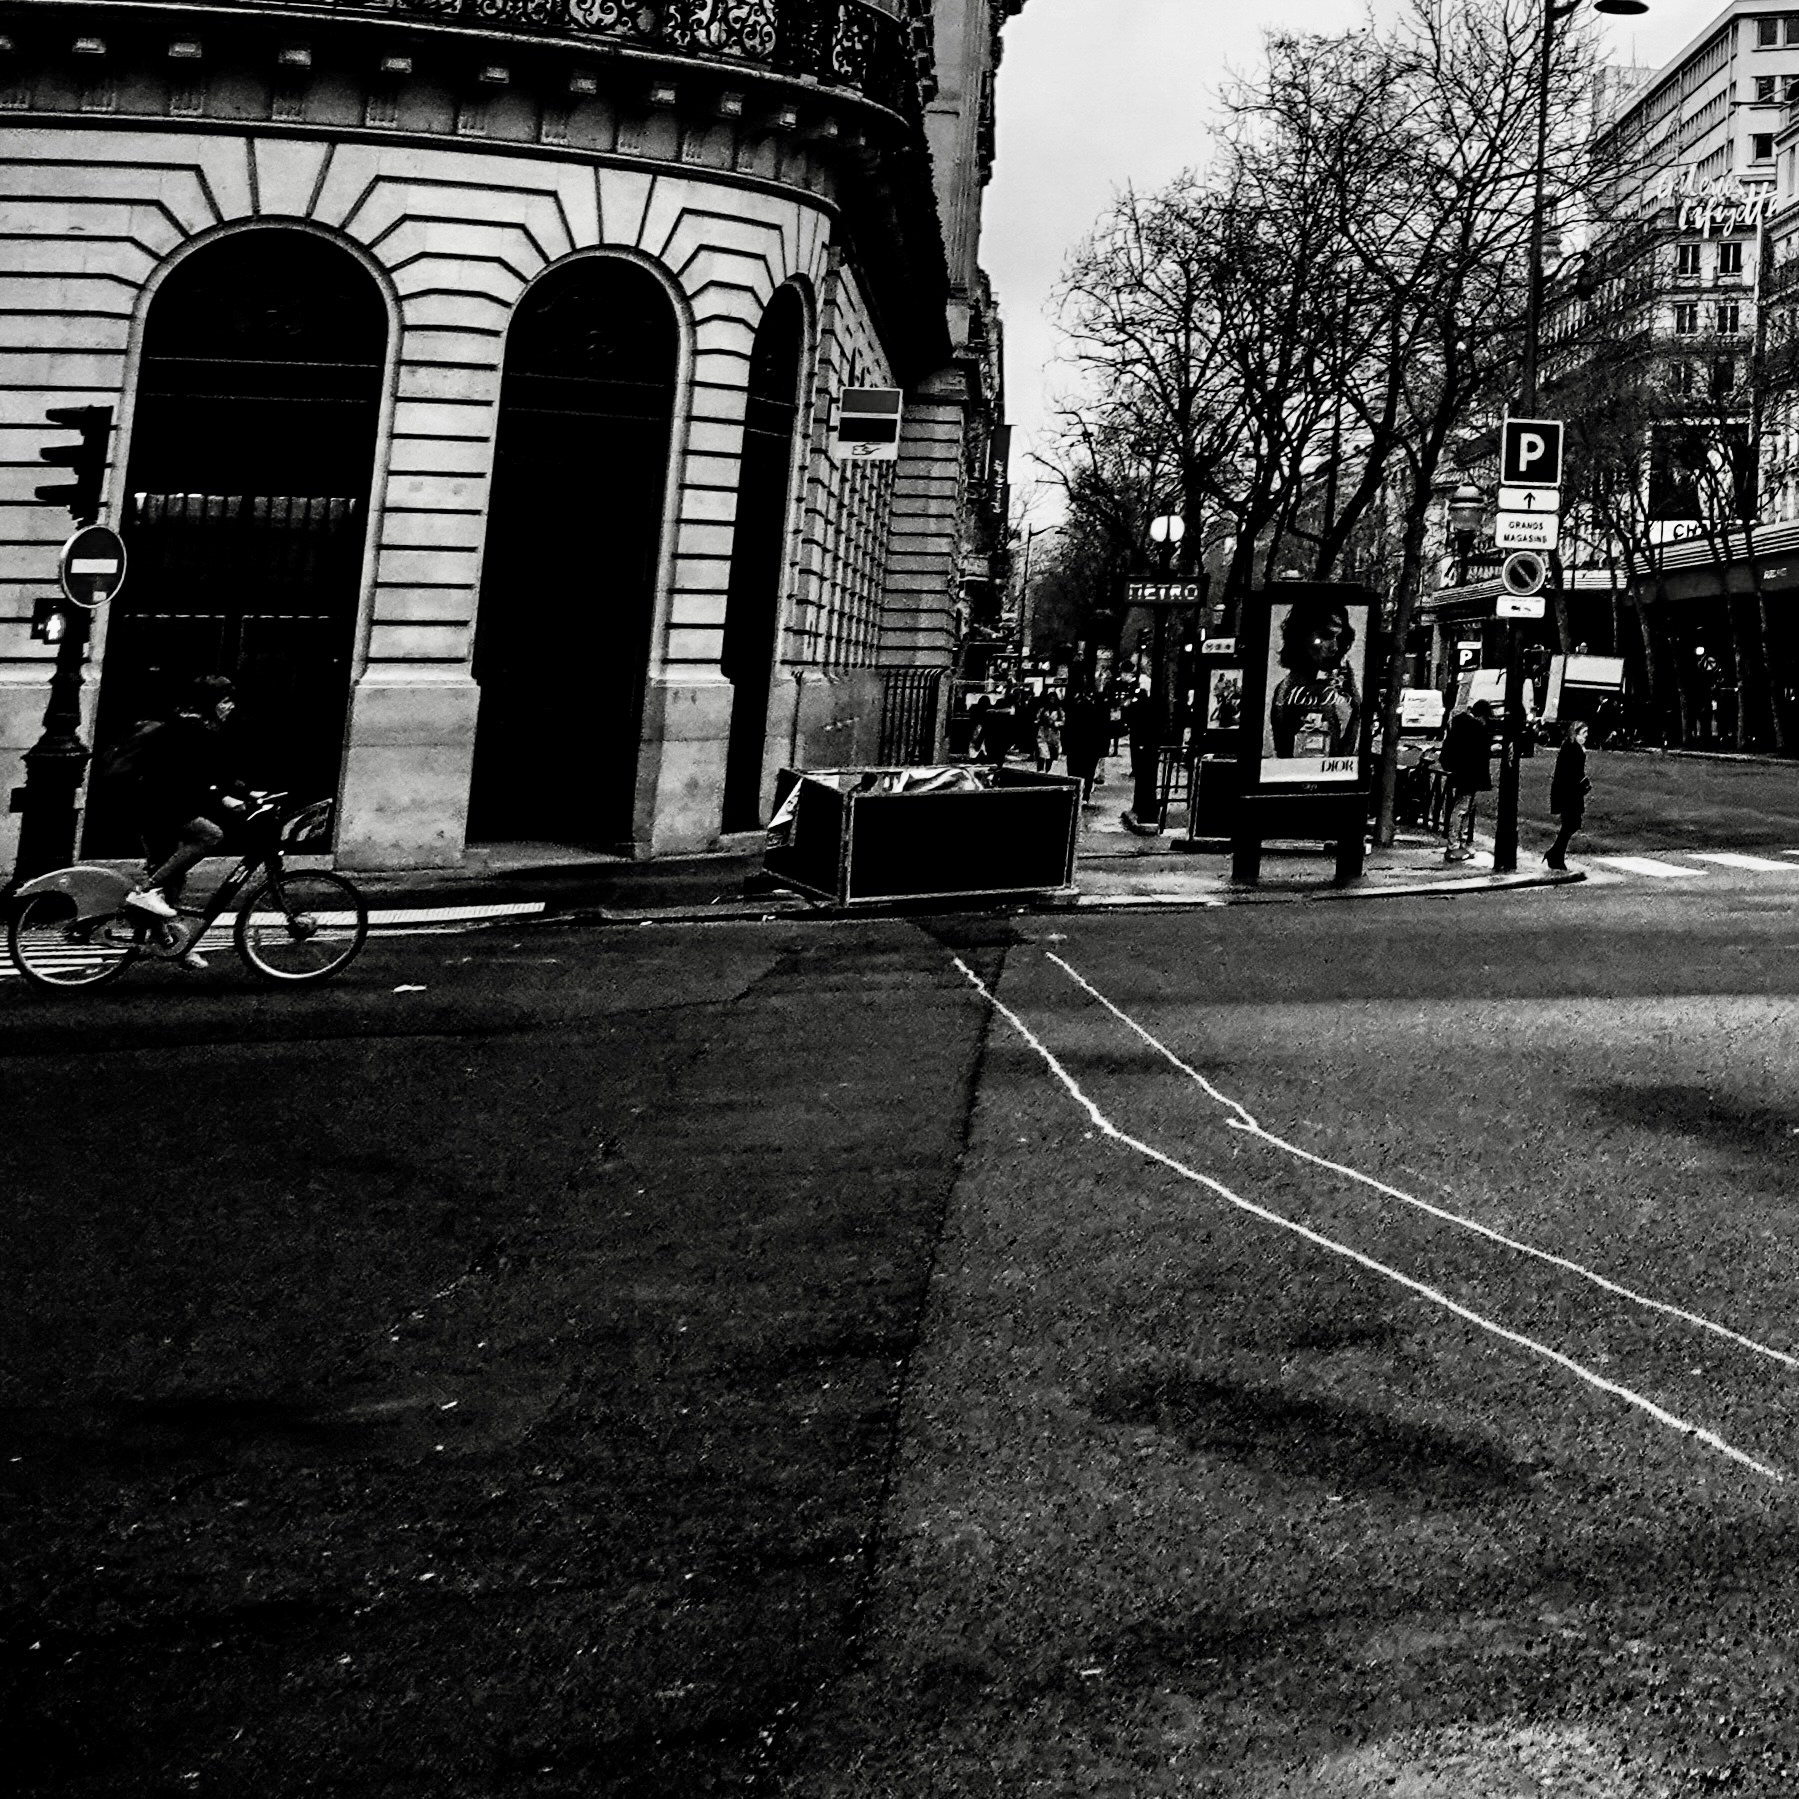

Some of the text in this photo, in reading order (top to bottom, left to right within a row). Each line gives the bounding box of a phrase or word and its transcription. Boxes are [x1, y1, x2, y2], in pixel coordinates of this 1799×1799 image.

[1519, 432, 1545, 472] P
[1508, 520, 1544, 531] GRANDS
[1503, 533, 1547, 544] MAGASINS
[1459, 649, 1473, 666] P
[1287, 686, 1318, 705] Miss
[1320, 760, 1354, 773] DIOR
